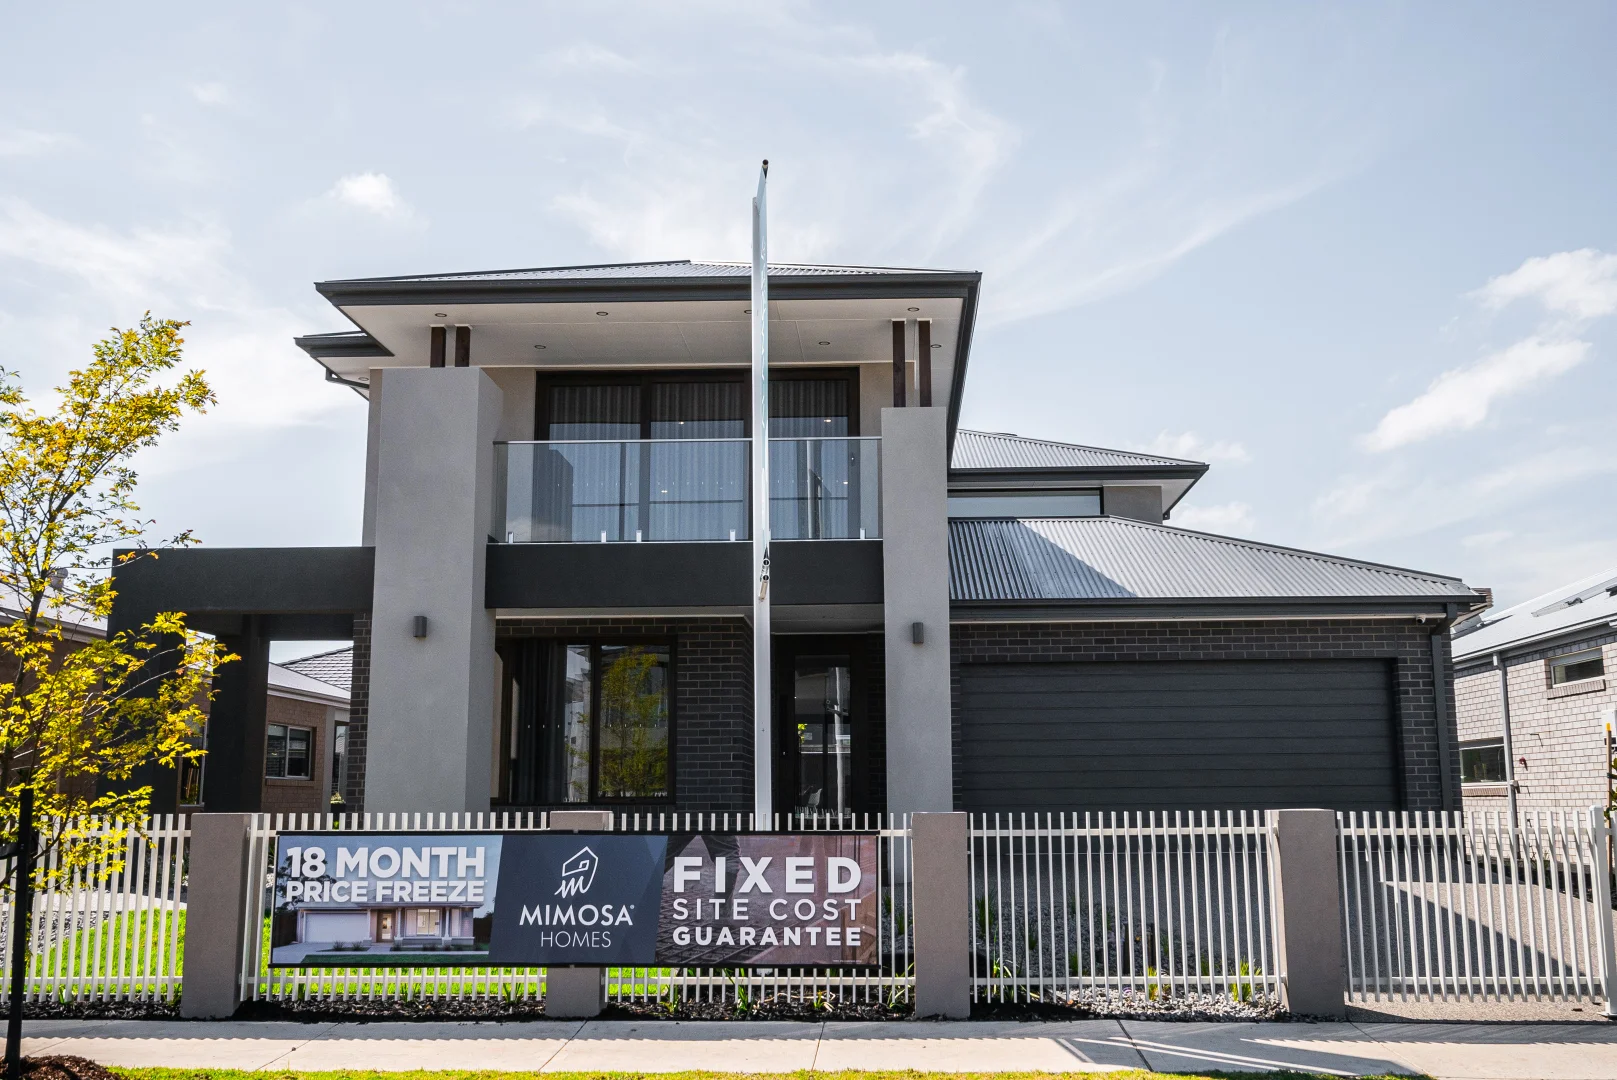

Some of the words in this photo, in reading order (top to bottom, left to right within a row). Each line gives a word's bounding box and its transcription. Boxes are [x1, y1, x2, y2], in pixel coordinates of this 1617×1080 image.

[287, 846, 326, 878] 18
[336, 846, 485, 878] MONTH
[673, 856, 862, 893] FIXED
[286, 880, 369, 902] PRICE
[672, 898, 749, 920] SITE
[769, 898, 862, 920] COST
[540, 930, 611, 948] HOMES
